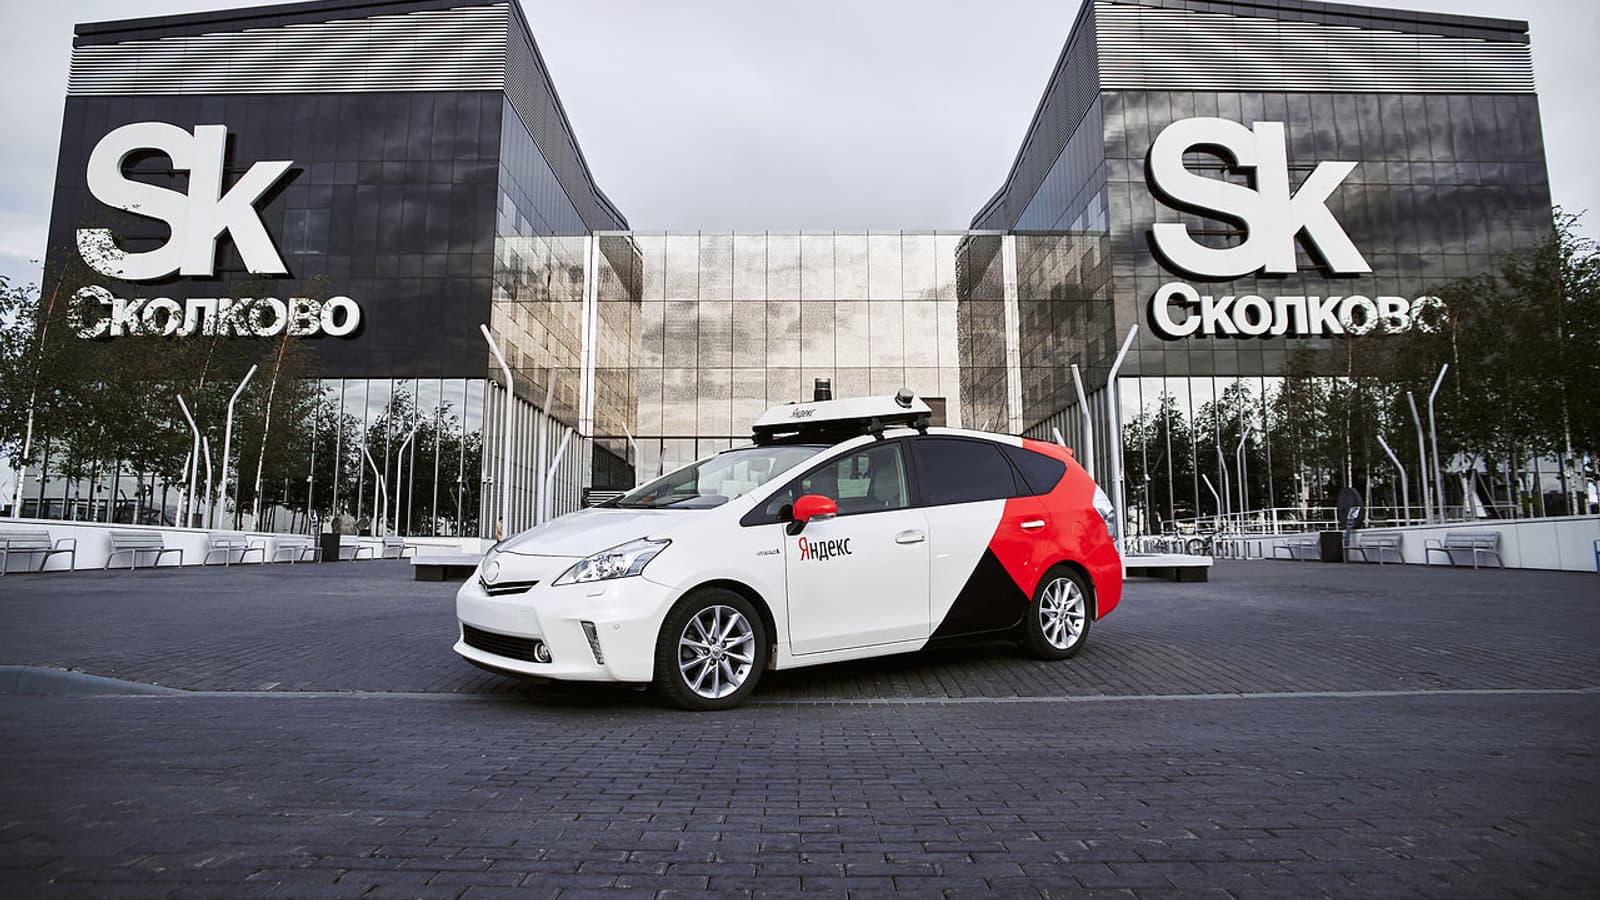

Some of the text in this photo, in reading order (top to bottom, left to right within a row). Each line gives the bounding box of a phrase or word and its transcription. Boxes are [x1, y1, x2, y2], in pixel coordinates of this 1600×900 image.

[76, 122, 294, 280] Sk
[1150, 117, 1373, 277] Sk
[798, 536, 853, 561] Яндекс
